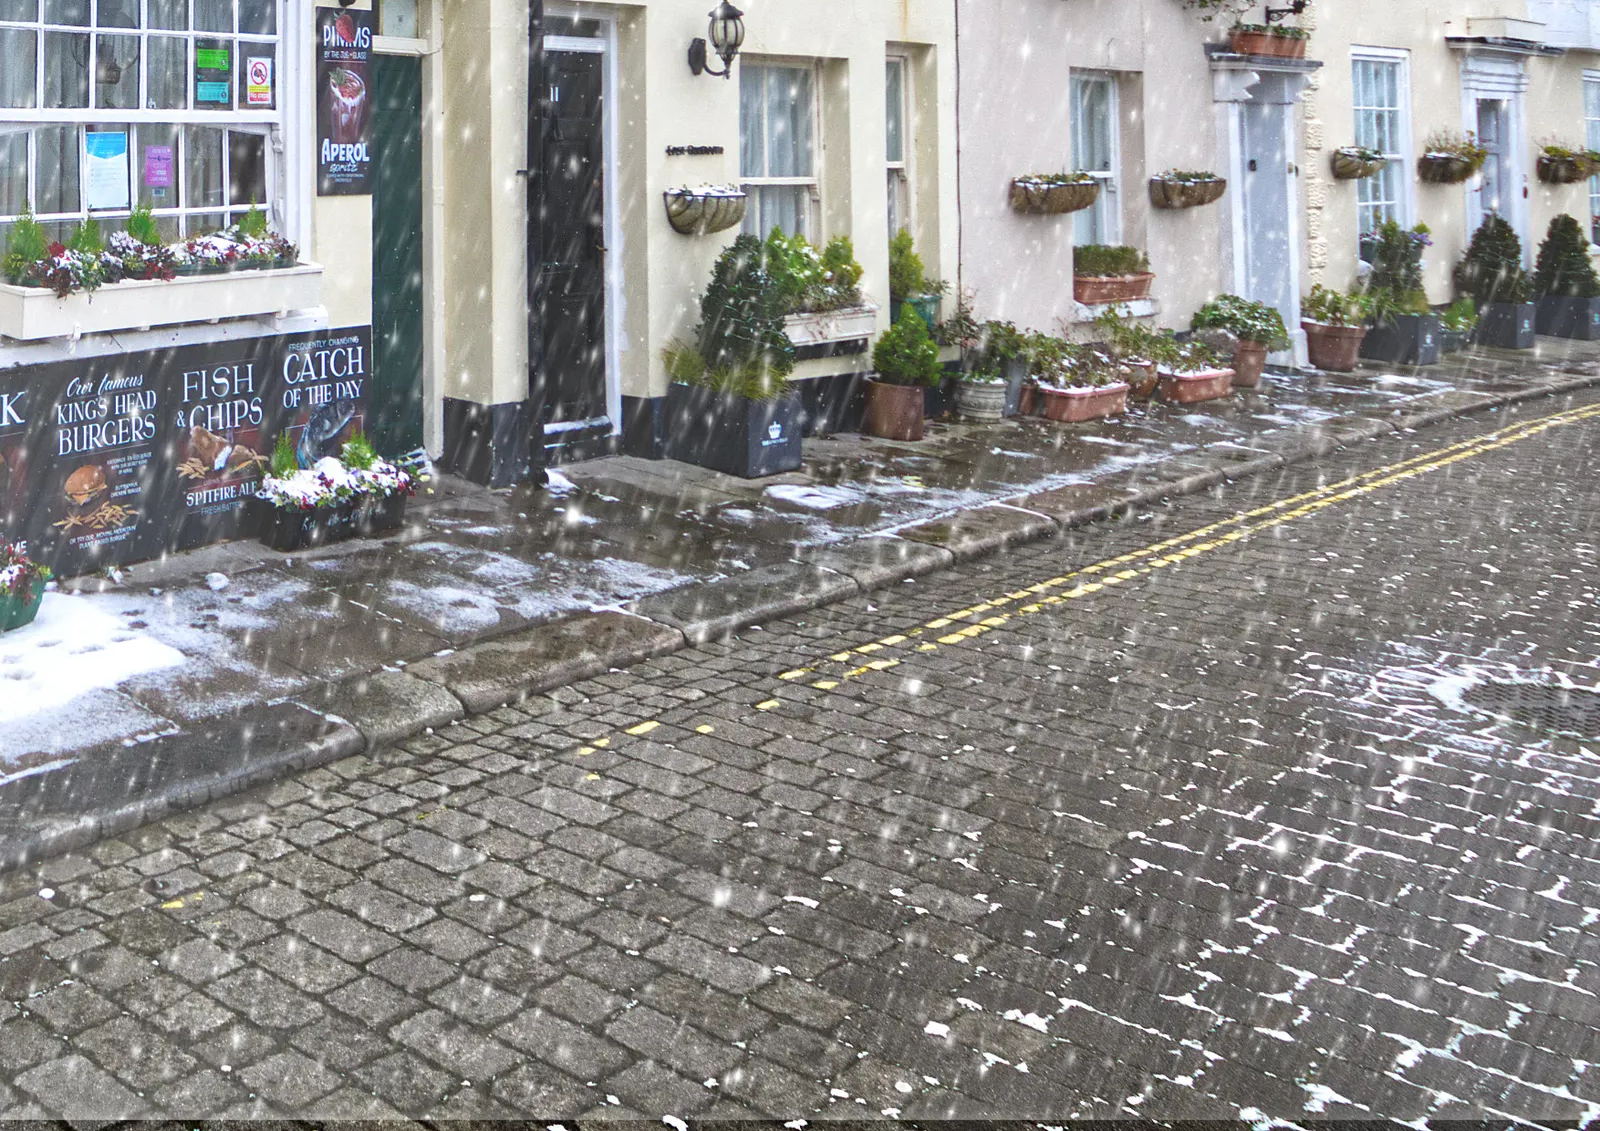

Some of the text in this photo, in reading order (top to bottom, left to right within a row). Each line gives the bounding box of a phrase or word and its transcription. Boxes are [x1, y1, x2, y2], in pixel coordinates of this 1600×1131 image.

[322, 138, 370, 164] APEROL
[289, 340, 326, 351] FREQUENTLY
[284, 346, 364, 384] CATCH
[67, 373, 143, 397] Our famous
[182, 364, 254, 402] FISH
[283, 379, 363, 408] OF THE DAY
[58, 390, 156, 424] KING'S HEAD
[177, 397, 263, 432] & CHIPS
[58, 414, 155, 456] BURGERS
[186, 485, 236, 506] SPITFIRE
